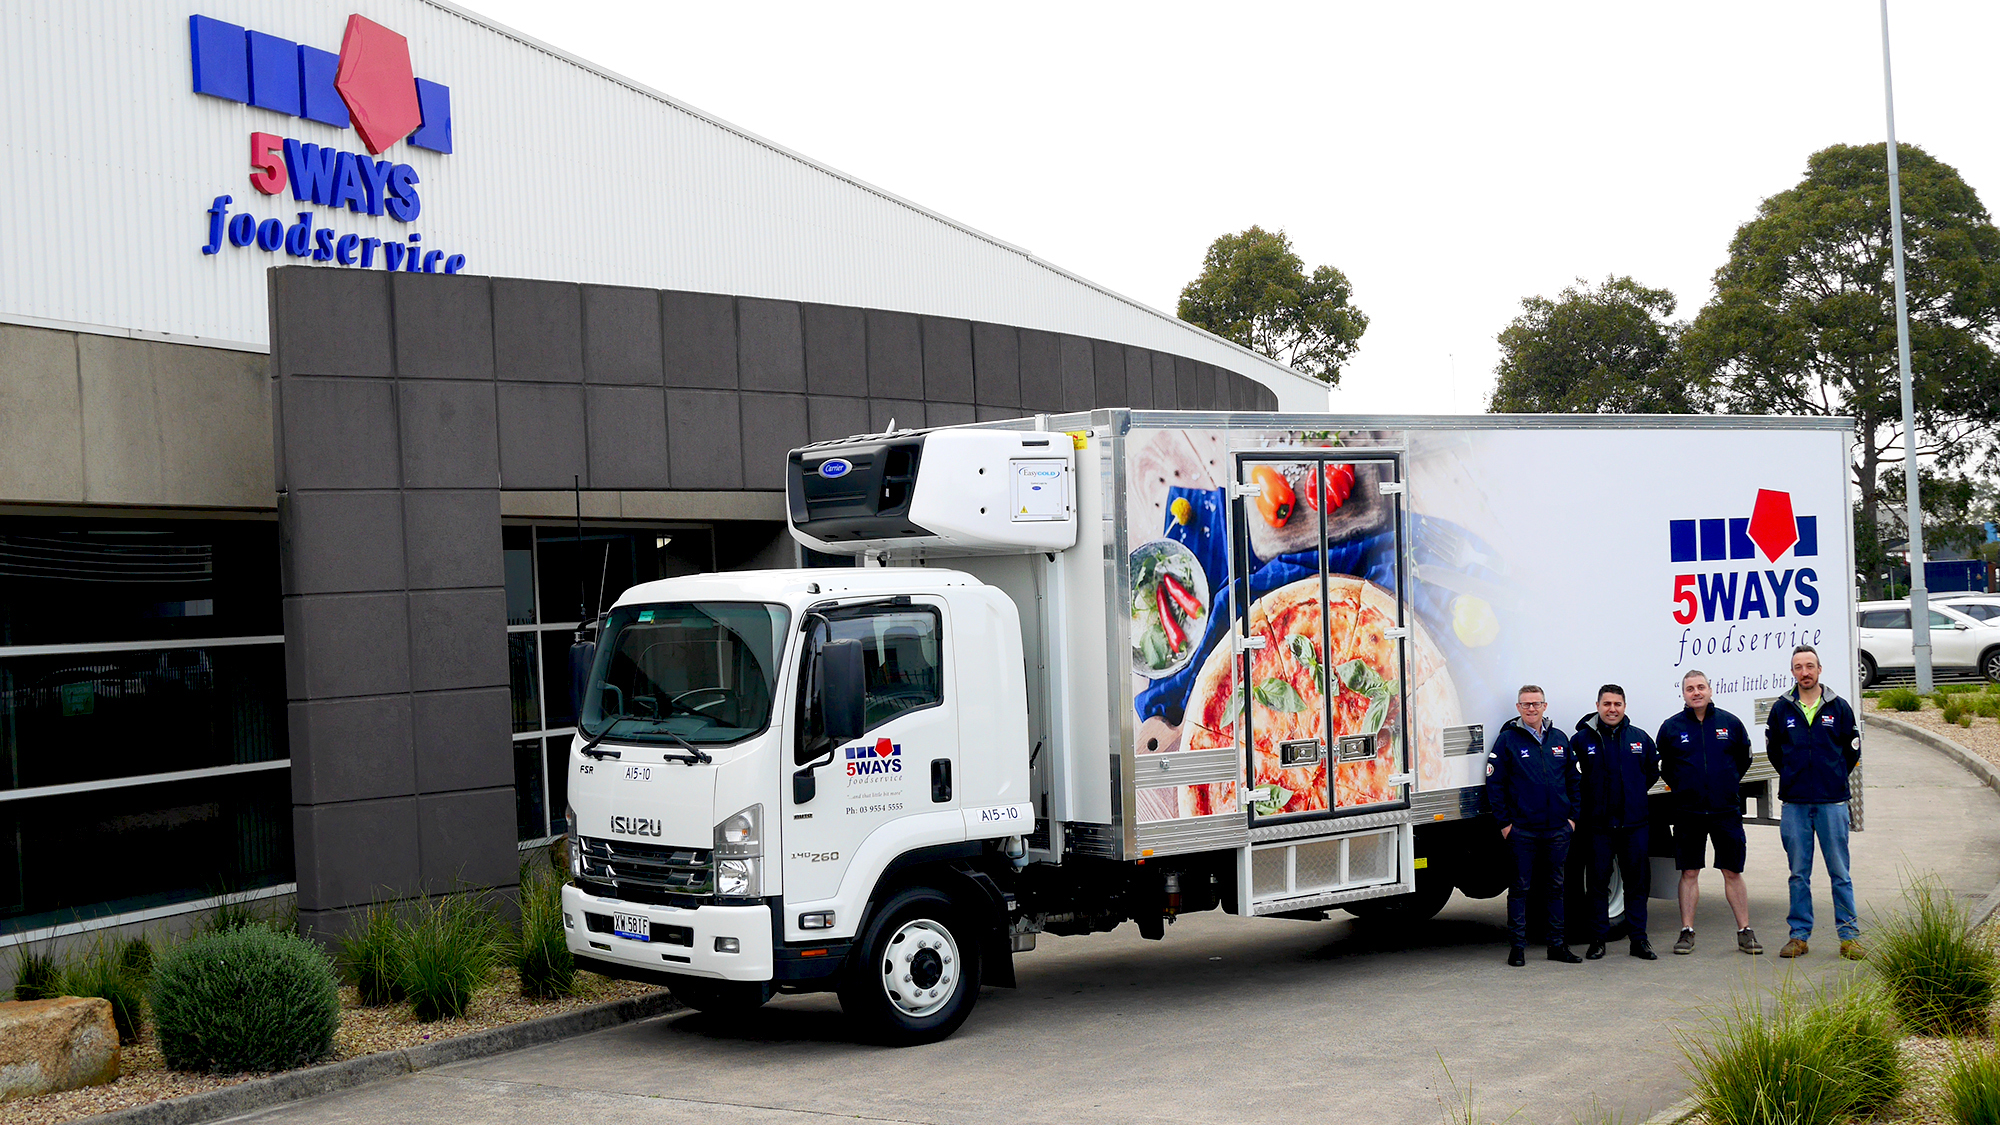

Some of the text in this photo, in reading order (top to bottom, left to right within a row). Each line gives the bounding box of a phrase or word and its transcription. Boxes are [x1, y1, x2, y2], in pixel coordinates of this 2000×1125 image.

[250, 131, 421, 223] 5WAYS
[202, 194, 466, 275] foodservice
[825, 464, 844, 473] Carrier
[1672, 567, 1820, 625] 5WAYS
[1674, 623, 1821, 667] foodservice
[1716, 678, 1738, 694] that
[1742, 675, 1768, 692] little
[1772, 673, 1787, 689] bit
[580, 765, 594, 775] FSR
[625, 767, 651, 780] A15-10
[846, 758, 902, 776] 5WAYS
[847, 774, 903, 788] foodservice
[845, 806, 858, 815] Ph:
[869, 804, 886, 813] 9554
[888, 803, 903, 811] 5555
[982, 807, 1018, 821] A15-10
[611, 815, 662, 836] ISUZU
[811, 851, 839, 863] 260
